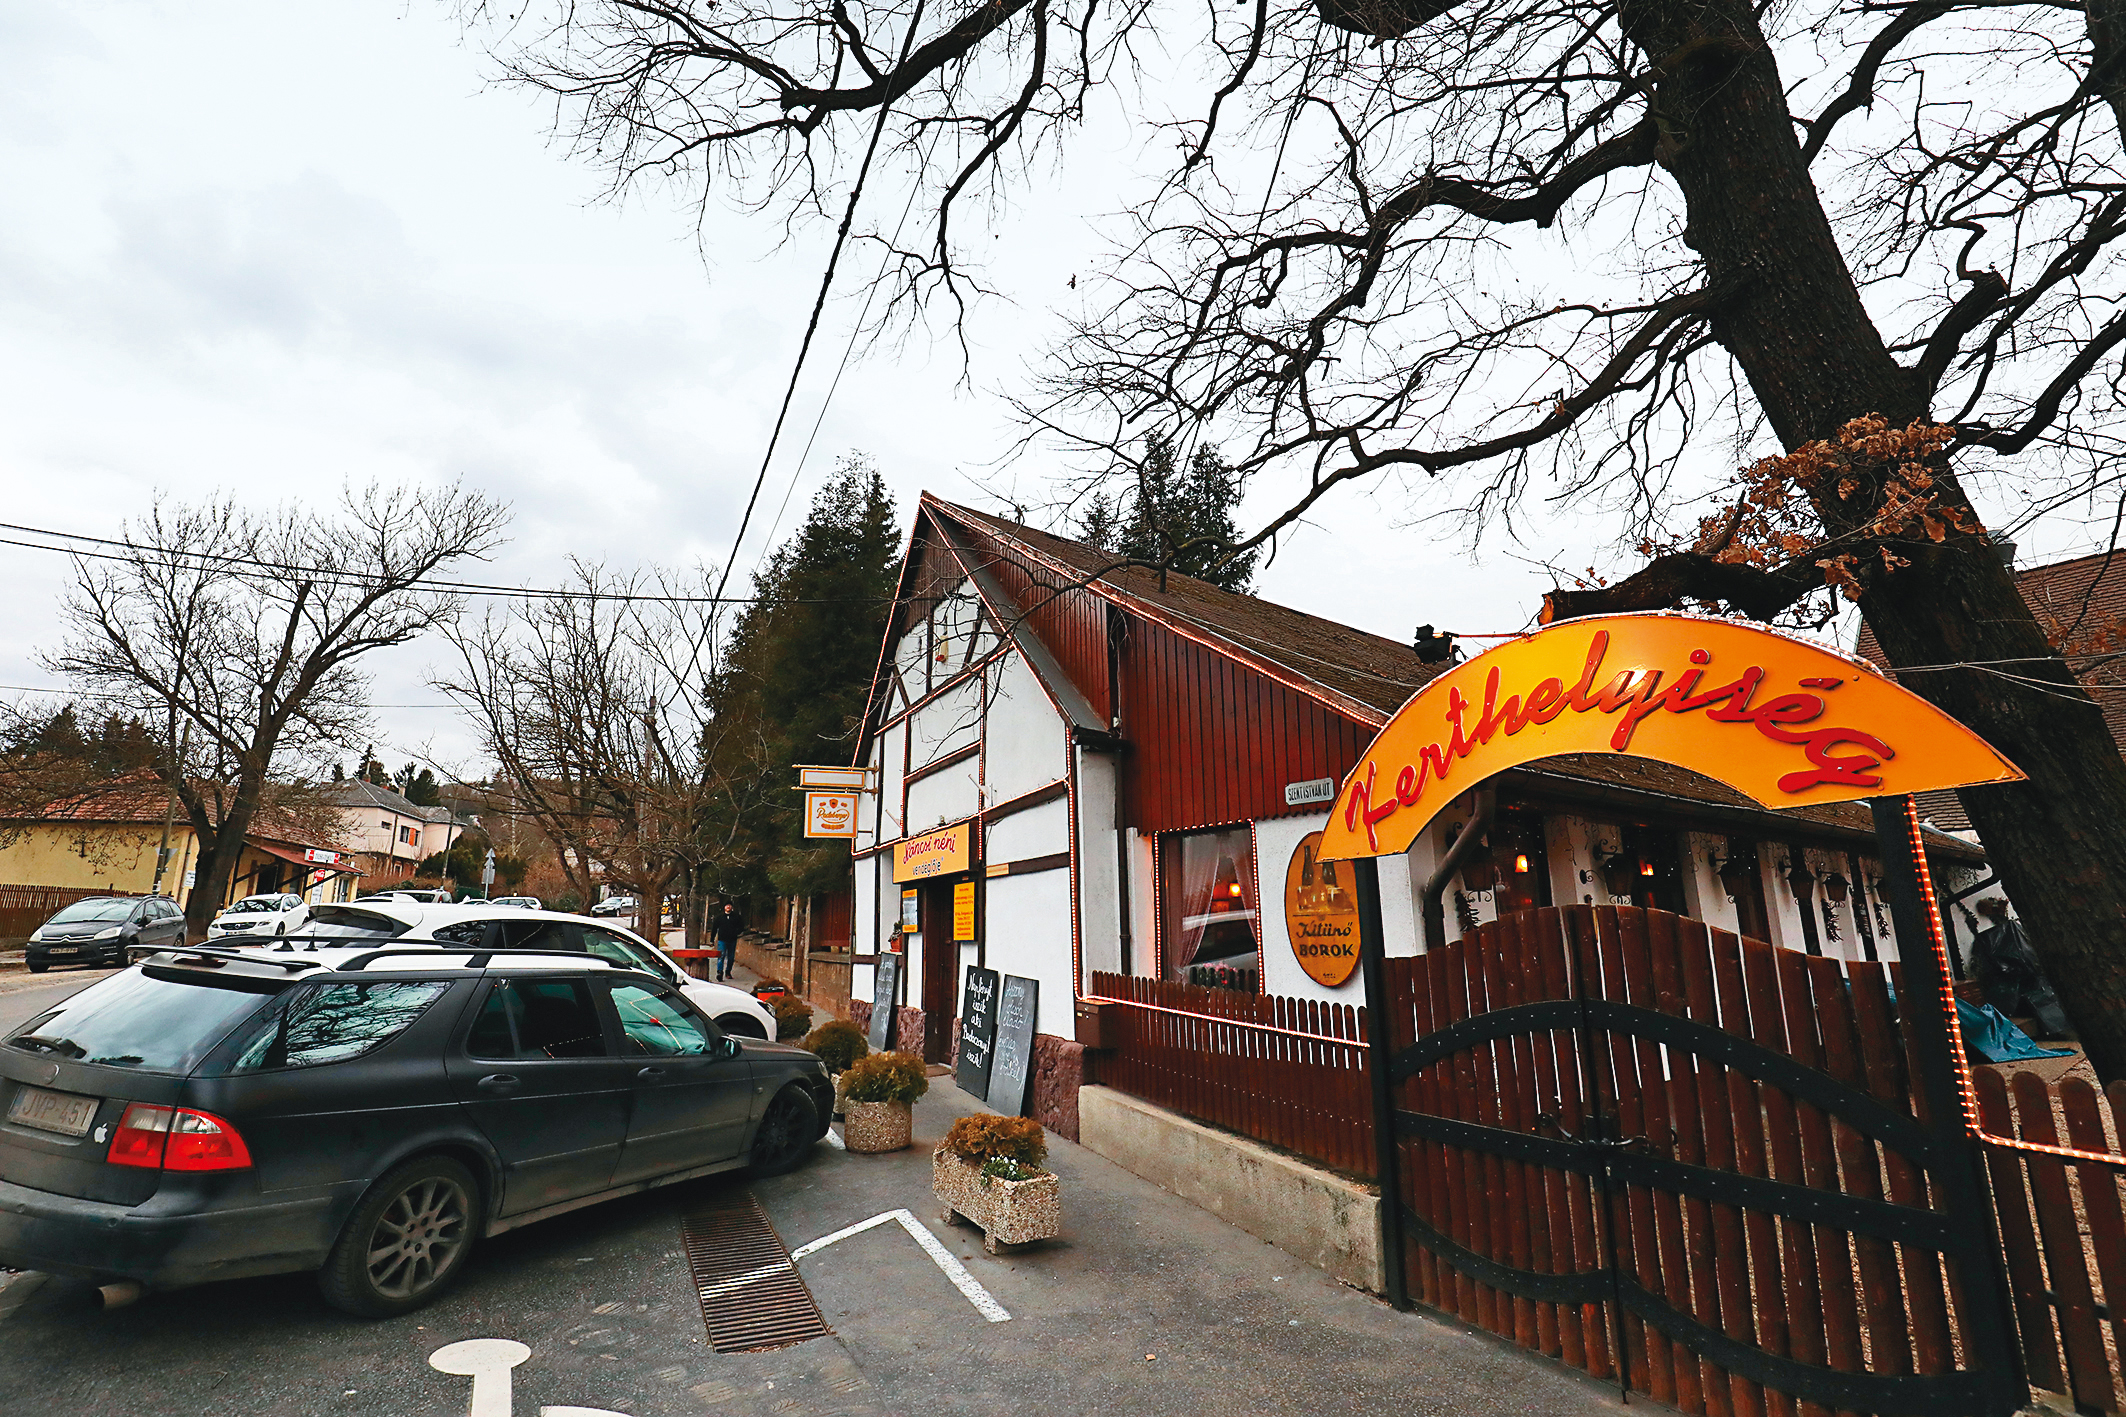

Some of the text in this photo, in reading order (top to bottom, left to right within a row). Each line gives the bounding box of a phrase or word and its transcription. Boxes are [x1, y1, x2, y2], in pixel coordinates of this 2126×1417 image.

[1345, 629, 1895, 852] Kerthelyiség
[1288, 786, 1303, 801] SZENT
[933, 831, 956, 853] néni
[1299, 943, 1354, 957] BOROK
[970, 1013, 982, 1028] aki
[22, 1093, 92, 1127] JVP-451
